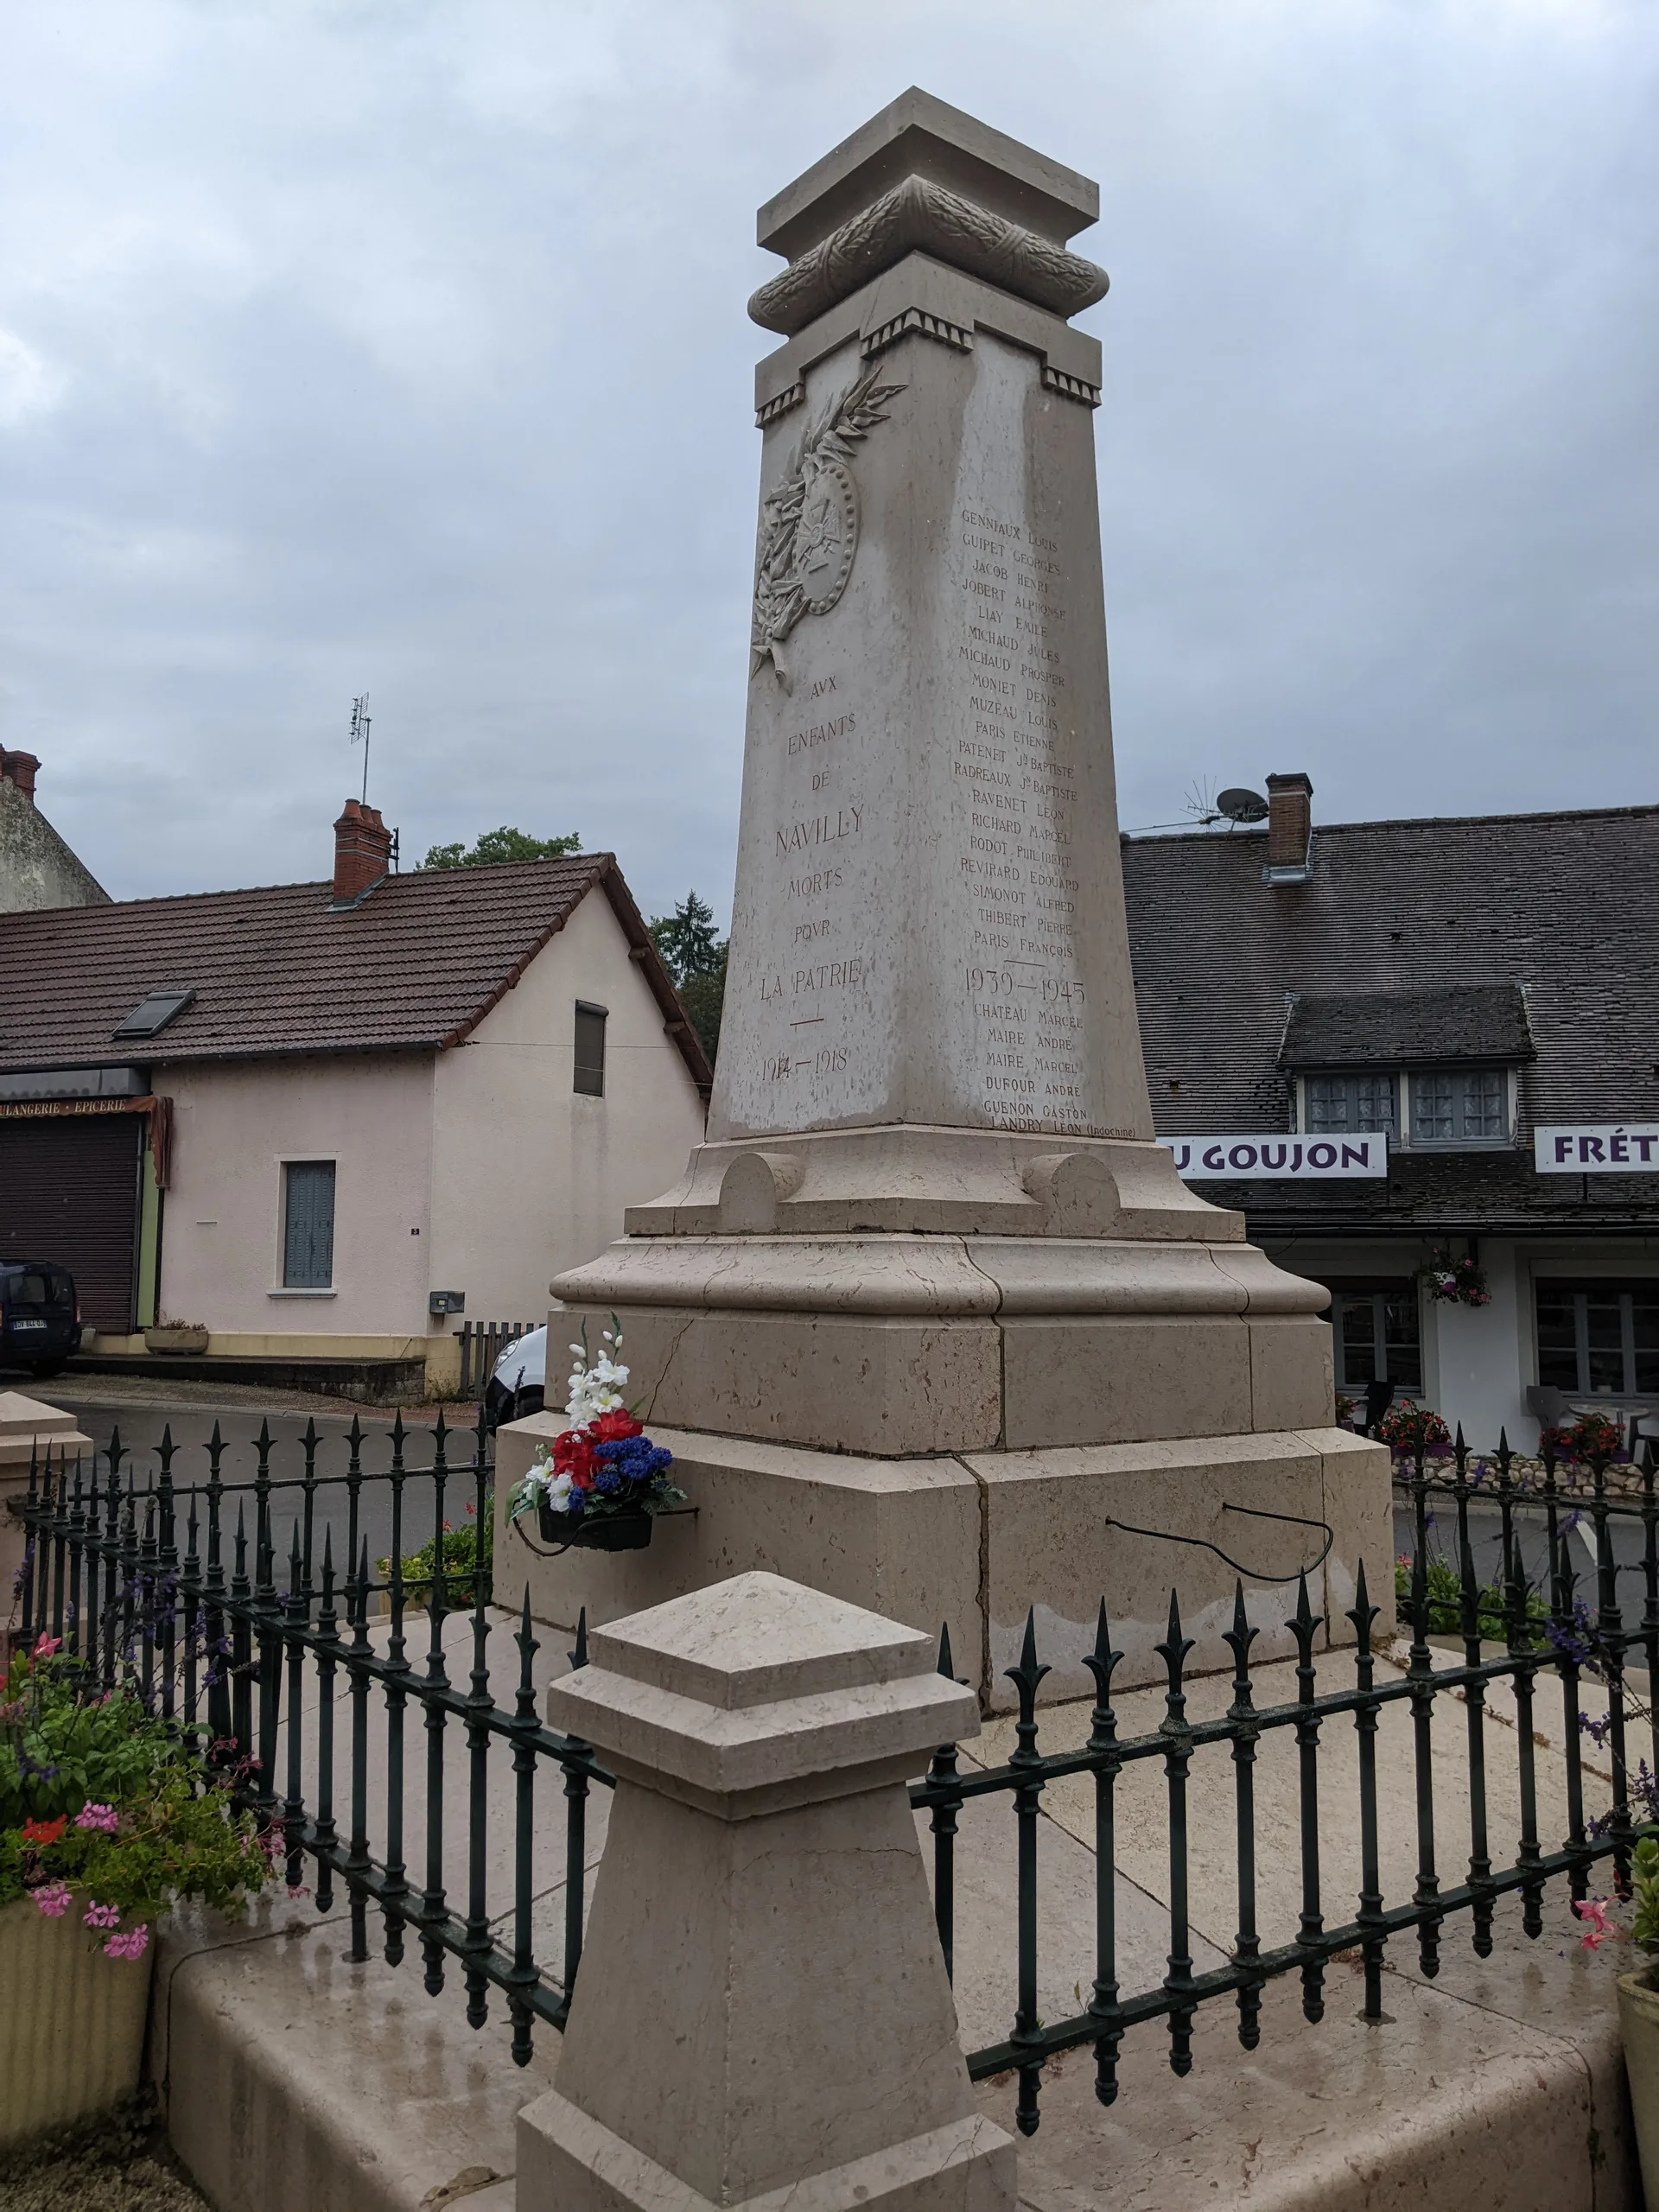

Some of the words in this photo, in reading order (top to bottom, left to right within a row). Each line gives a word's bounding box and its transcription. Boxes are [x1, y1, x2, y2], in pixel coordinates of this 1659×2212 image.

[962, 509, 1020, 540] GENNIAUX
[1028, 532, 1058, 552] LOUIS
[963, 533, 1005, 556] GUIPET
[1013, 550, 1061, 575] GEORGES
[972, 559, 1008, 580] JACOB
[1017, 573, 1048, 594] HENRI
[962, 578, 1006, 601] JOBERT
[1014, 596, 1067, 621] ALPHONSE
[978, 606, 1003, 624] LIAY
[1015, 617, 1048, 638] EMILE
[968, 626, 1019, 651] MICHAUD
[1027, 644, 1059, 664] JULES
[958, 646, 1010, 671] MICHAUD
[1020, 664, 1065, 687] PROSPER
[971, 673, 1016, 696] MONIET
[1026, 688, 1057, 707] DENIS
[969, 696, 1017, 720] MUZEAU
[1028, 711, 1058, 730] LOUIS
[787, 713, 856, 756] ENFANTS
[976, 721, 1006, 740] PARIS
[1013, 730, 1055, 752] ETIENNE
[958, 740, 1007, 763] PATENET
[1031, 757, 1074, 779] BAPTISTE
[811, 770, 830, 791] DE
[954, 761, 1011, 787] RADREAUX
[1033, 780, 1078, 802] BAPTISTE
[972, 789, 1027, 813] RAVENET
[774, 804, 864, 857] NAVILLY
[971, 812, 1021, 835] RICHARD
[1029, 824, 1071, 845] MARCEL
[970, 836, 1007, 855] RODOT
[1016, 845, 1071, 868] PHILIBERT
[787, 868, 843, 900] MORTS
[960, 857, 1020, 880] REVIRARD
[1030, 870, 1079, 892] EDOUARD
[973, 883, 1027, 905] SIMONOT
[1036, 896, 1075, 913] ALFRED
[977, 908, 1027, 928] THIBERT
[1037, 918, 1072, 936] PIERRE
[974, 930, 1009, 948] PARIS
[1020, 938, 1073, 957] FRANÇOIS
[760, 976, 784, 1001] LA
[794, 958, 861, 996] PATRIE
[974, 1003, 1027, 1021] CHATEAU
[1039, 1010, 1083, 1028] MARCEL
[987, 1028, 1025, 1045] MAIRE
[1037, 1036, 1072, 1051] ANDRÉ
[986, 1052, 1024, 1069] MAIRE
[1034, 1057, 1077, 1074] MARCEL
[985, 1076, 1036, 1093] DUFOUR
[1045, 1082, 1081, 1096] ANDRÉ
[74, 1099, 127, 1113] EPICERIE
[983, 1100, 1034, 1116] GUENON
[1043, 1105, 1087, 1120] GASTON
[991, 1116, 1044, 1132] LANDRY
[1053, 1120, 1082, 1134] LÉON
[1086, 1122, 1136, 1138] (Indochine)
[1202, 1141, 1370, 1173] GOUJON
[1554, 1126, 1659, 1164] FRÉT
